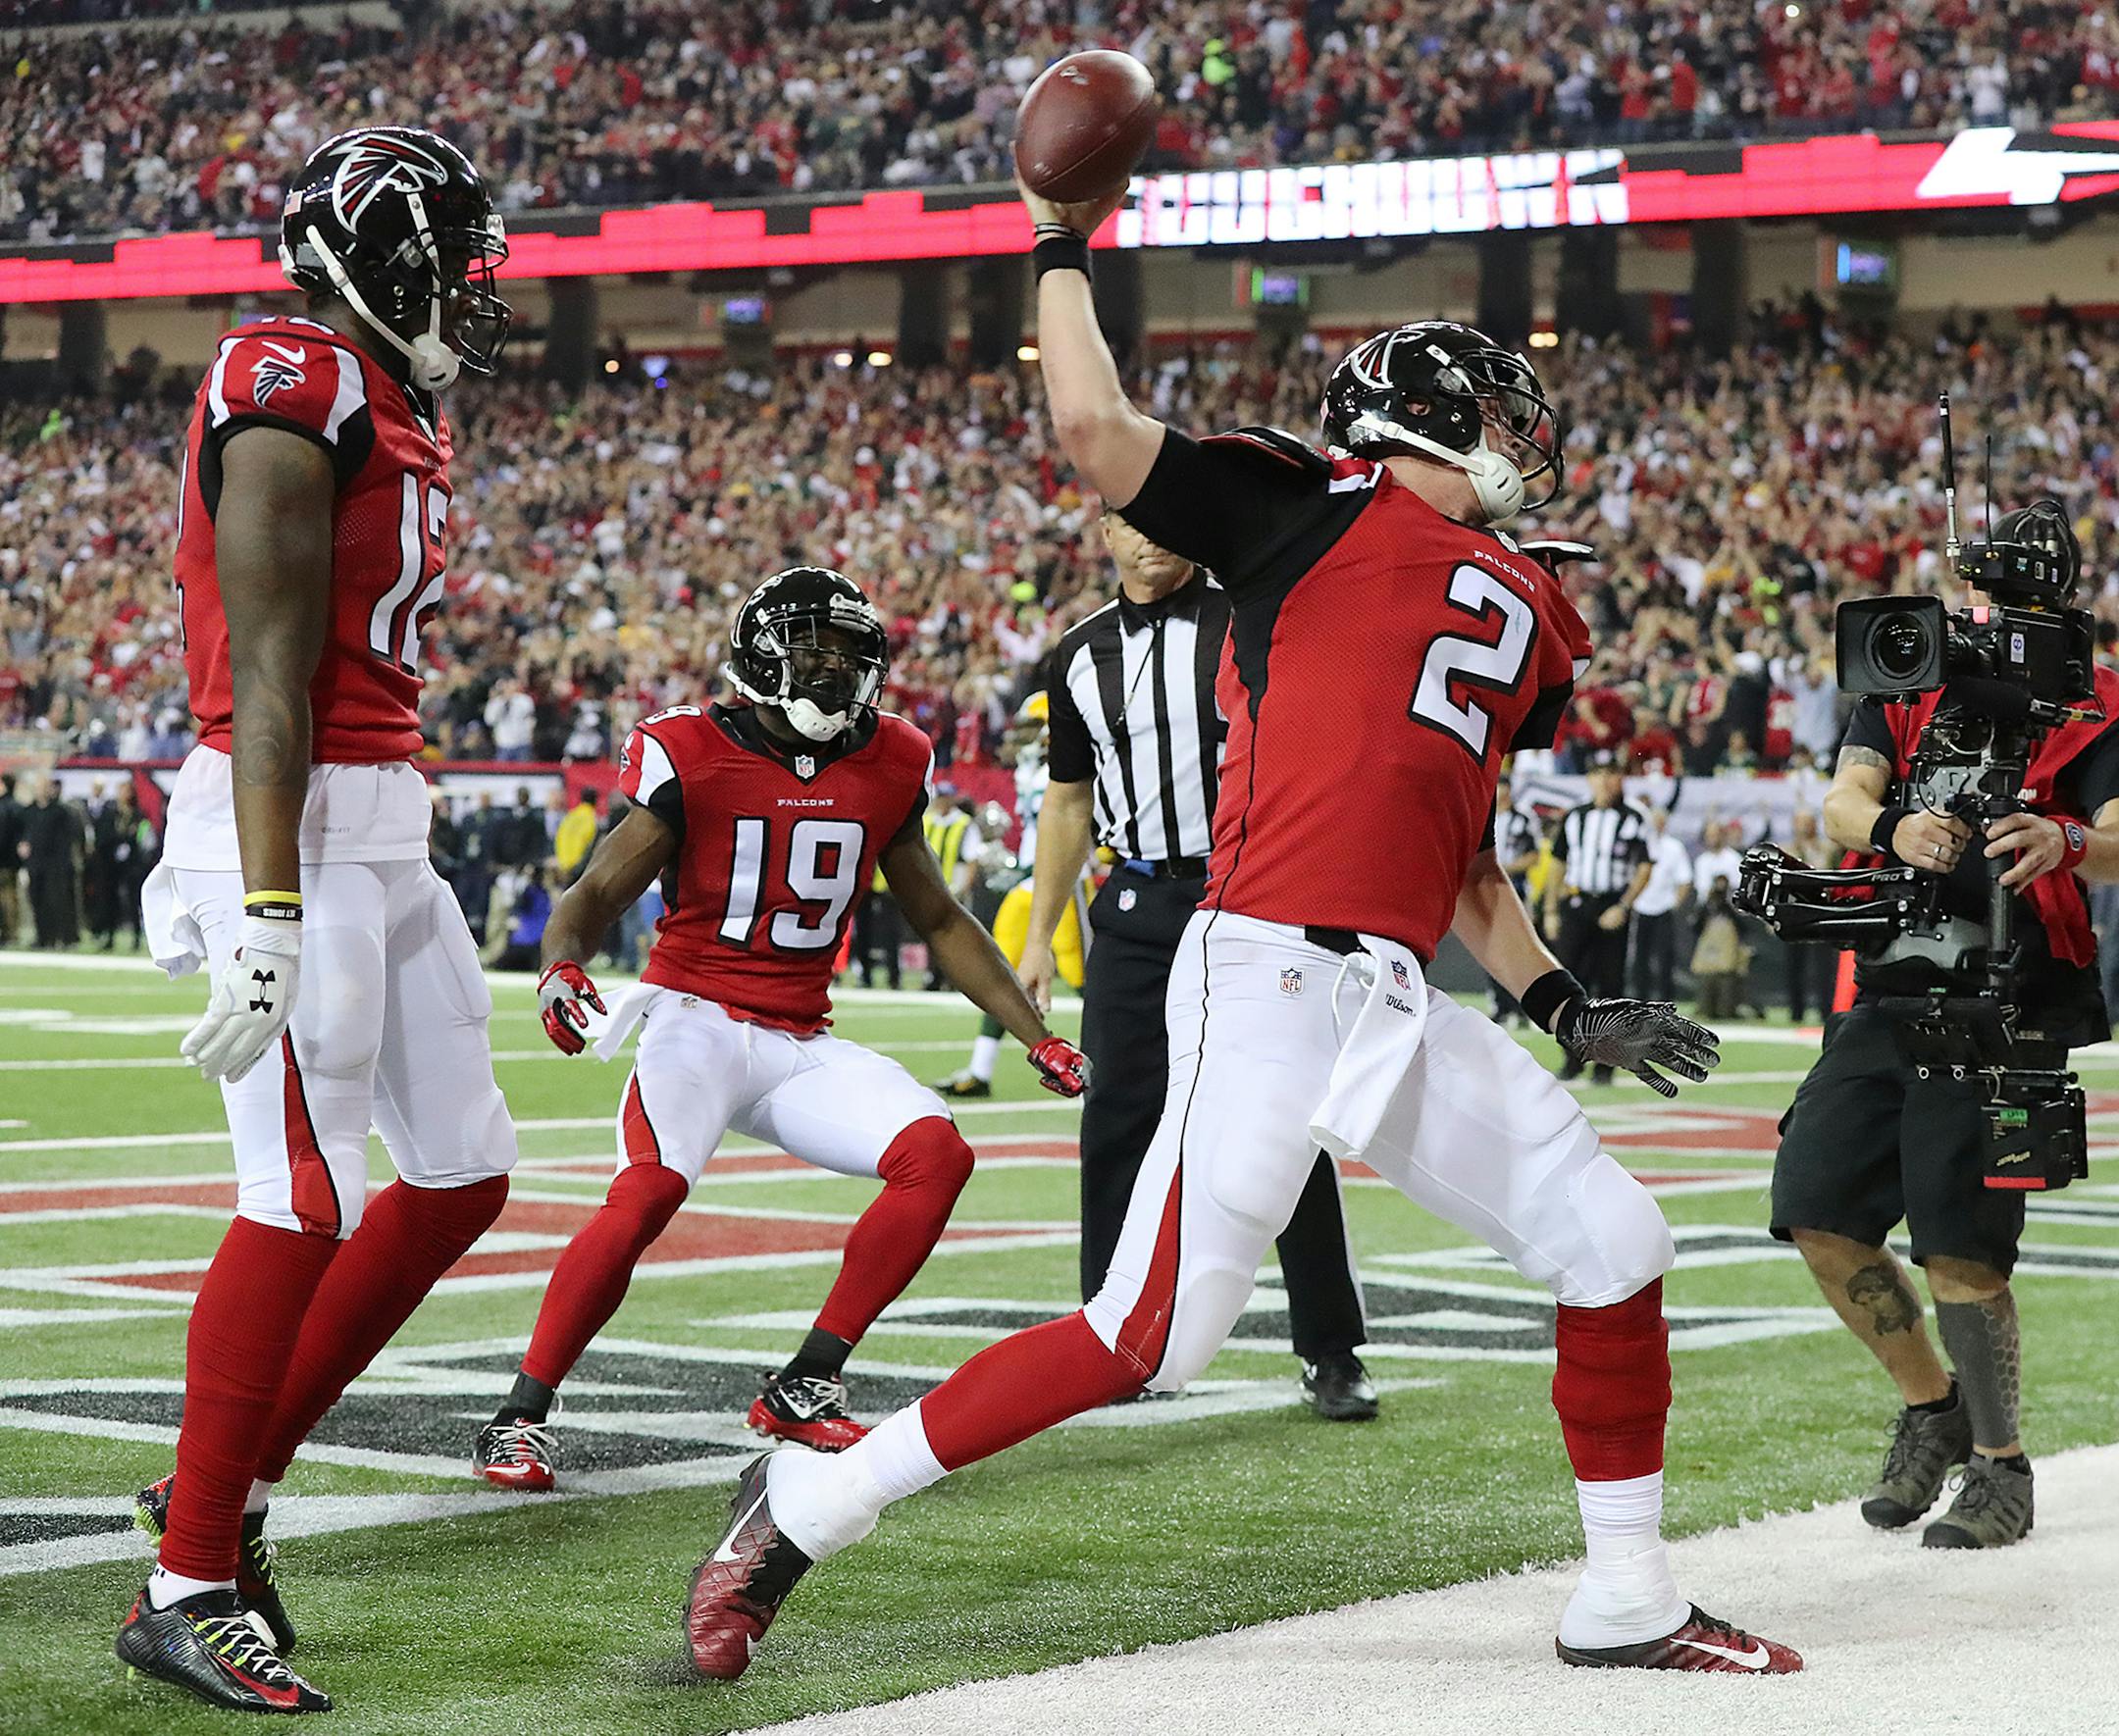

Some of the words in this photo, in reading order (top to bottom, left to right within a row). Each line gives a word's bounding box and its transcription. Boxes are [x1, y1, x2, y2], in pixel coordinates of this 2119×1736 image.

[1473, 549, 1536, 592] FALCONS
[1410, 561, 1538, 764] 2
[718, 817, 867, 951] 19
[1871, 872, 1900, 882] PRO
